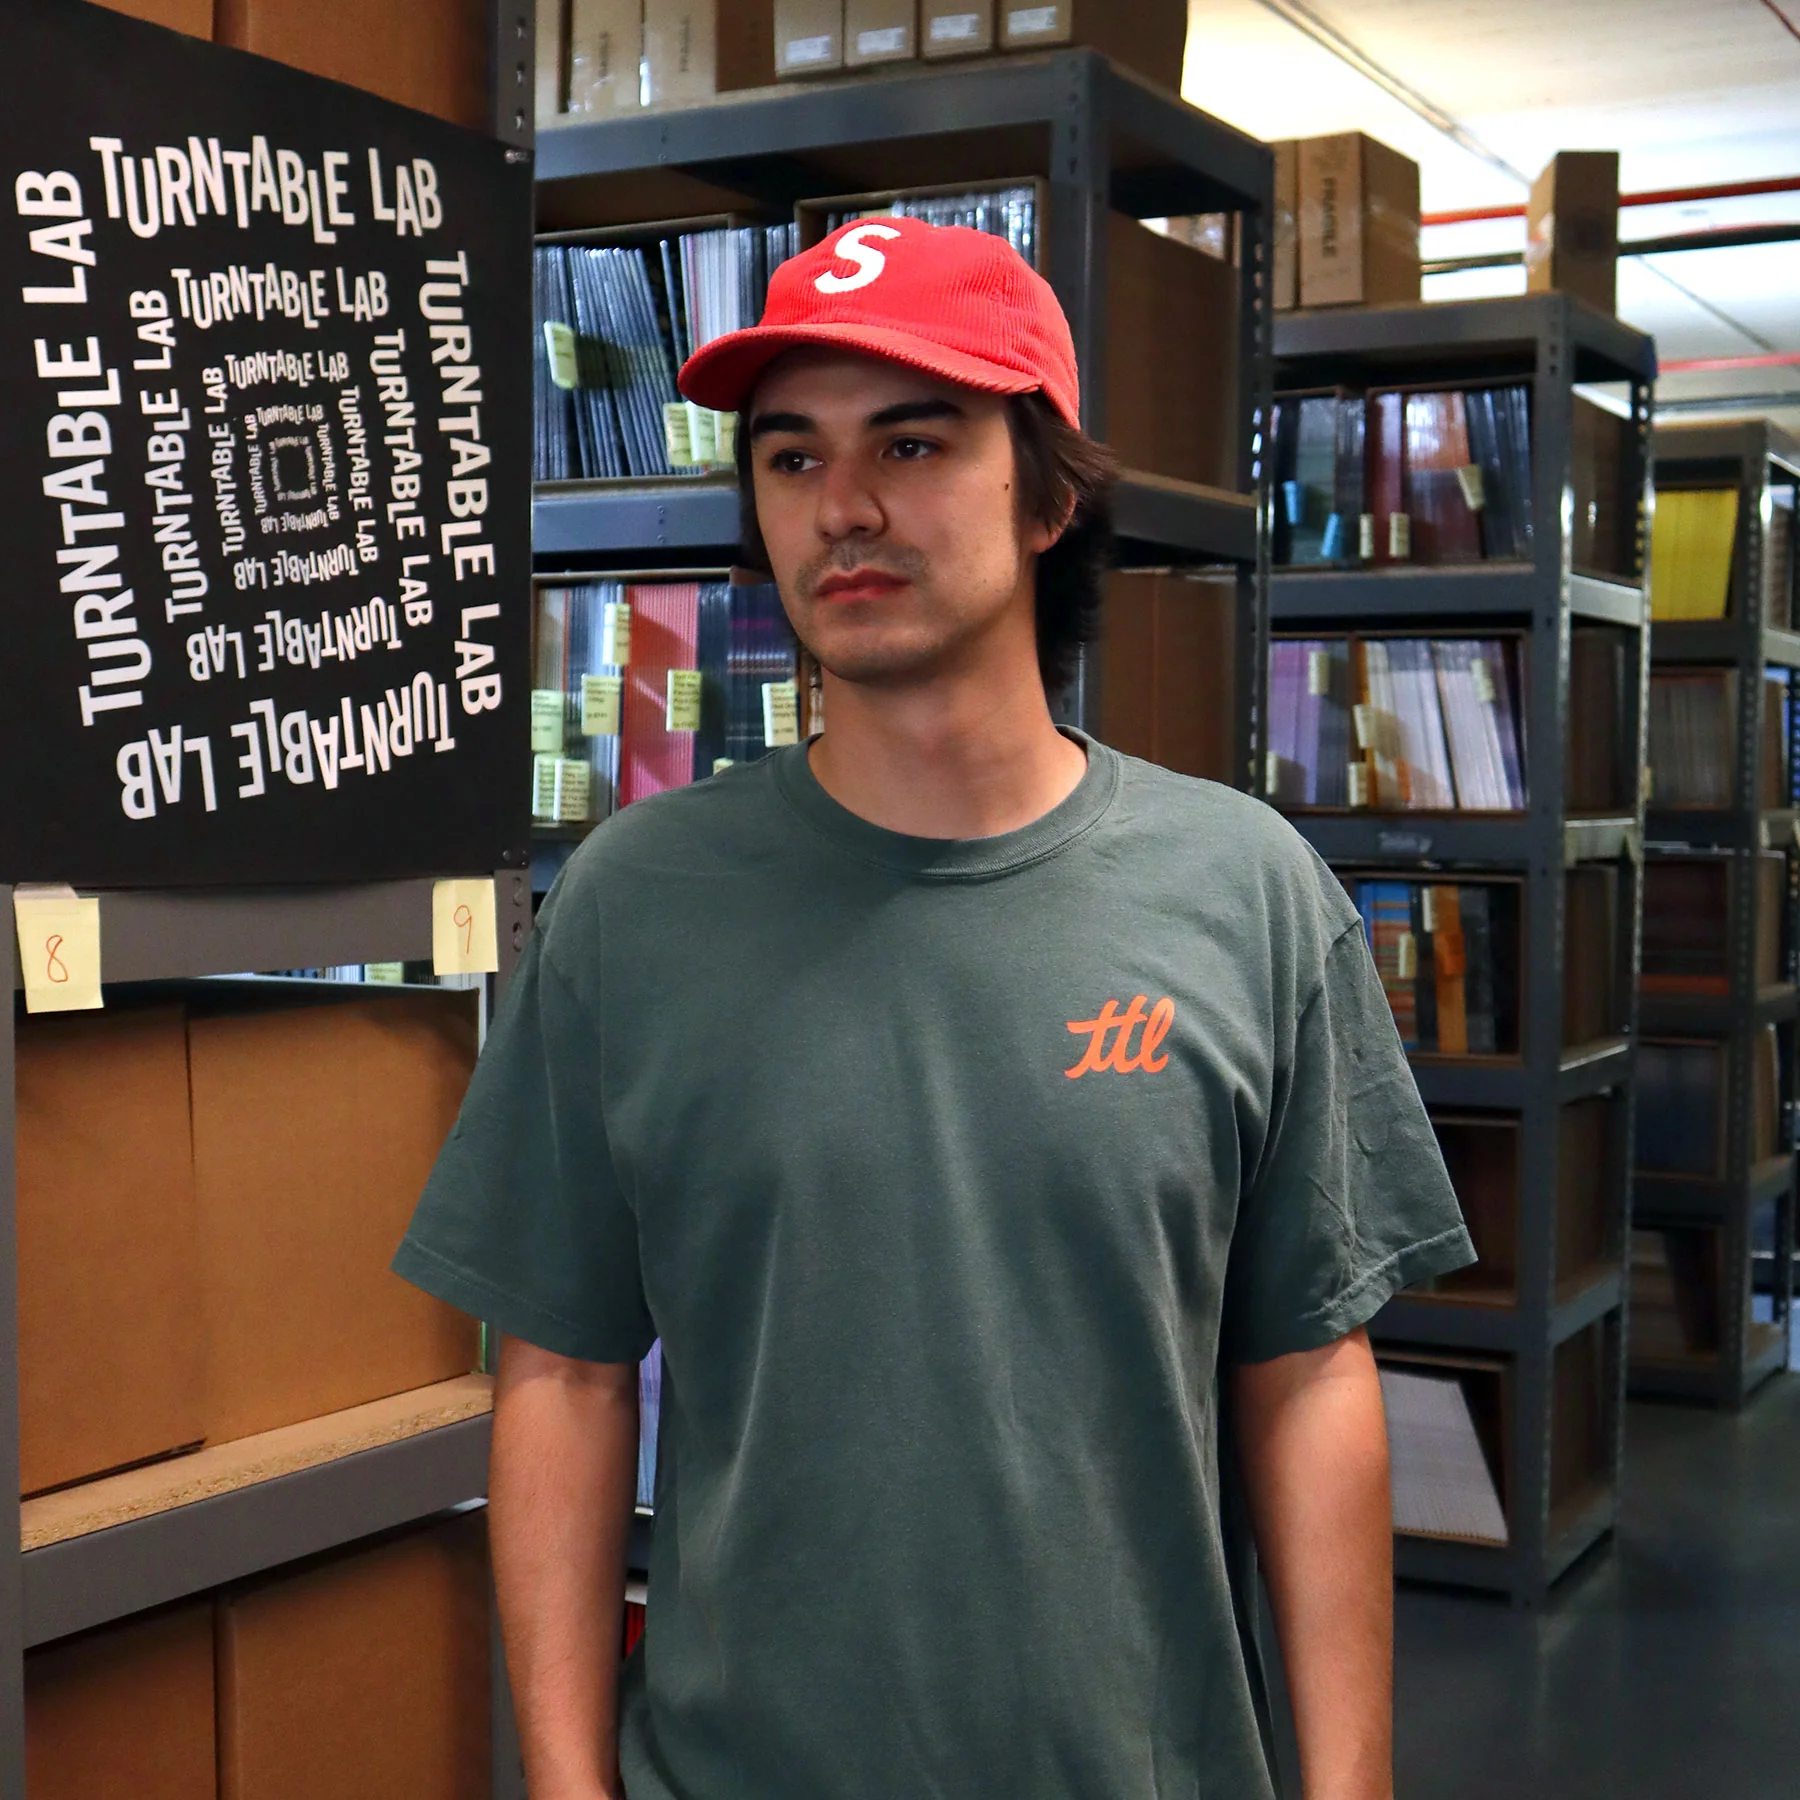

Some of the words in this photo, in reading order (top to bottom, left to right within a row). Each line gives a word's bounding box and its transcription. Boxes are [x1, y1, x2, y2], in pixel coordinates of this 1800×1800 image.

[88, 135, 356, 245] TURNTABLE
[367, 147, 443, 237] LAB
[14, 169, 97, 304] LAB
[814, 223, 902, 294] S
[128, 289, 177, 371] LAB
[170, 262, 330, 330] TURNTABLE
[335, 266, 390, 323] LAB
[201, 366, 229, 414] LAB
[224, 348, 316, 390] TURNTABLE
[317, 348, 351, 383] LAB
[338, 384, 374, 512] TURNTABLE
[418, 250, 496, 582] TURNTABLE
[139, 387, 209, 624] TURNTABLE
[207, 422, 246, 557] TURNTABLE
[369, 326, 427, 541] TURNTABLE
[398, 554, 434, 627] LAB
[33, 336, 153, 727] TURNTABLE
[270, 543, 360, 587] TURNTABLE
[354, 518, 379, 563] LAB
[233, 556, 268, 591] LAB
[186, 623, 247, 682] LAB
[253, 596, 403, 672] TURNTABLE
[454, 602, 503, 716] LAB
[116, 724, 218, 820] LAB
[230, 671, 456, 799] TURNTABLE
[45, 934, 68, 983] 8
[453, 905, 473, 954] 9
